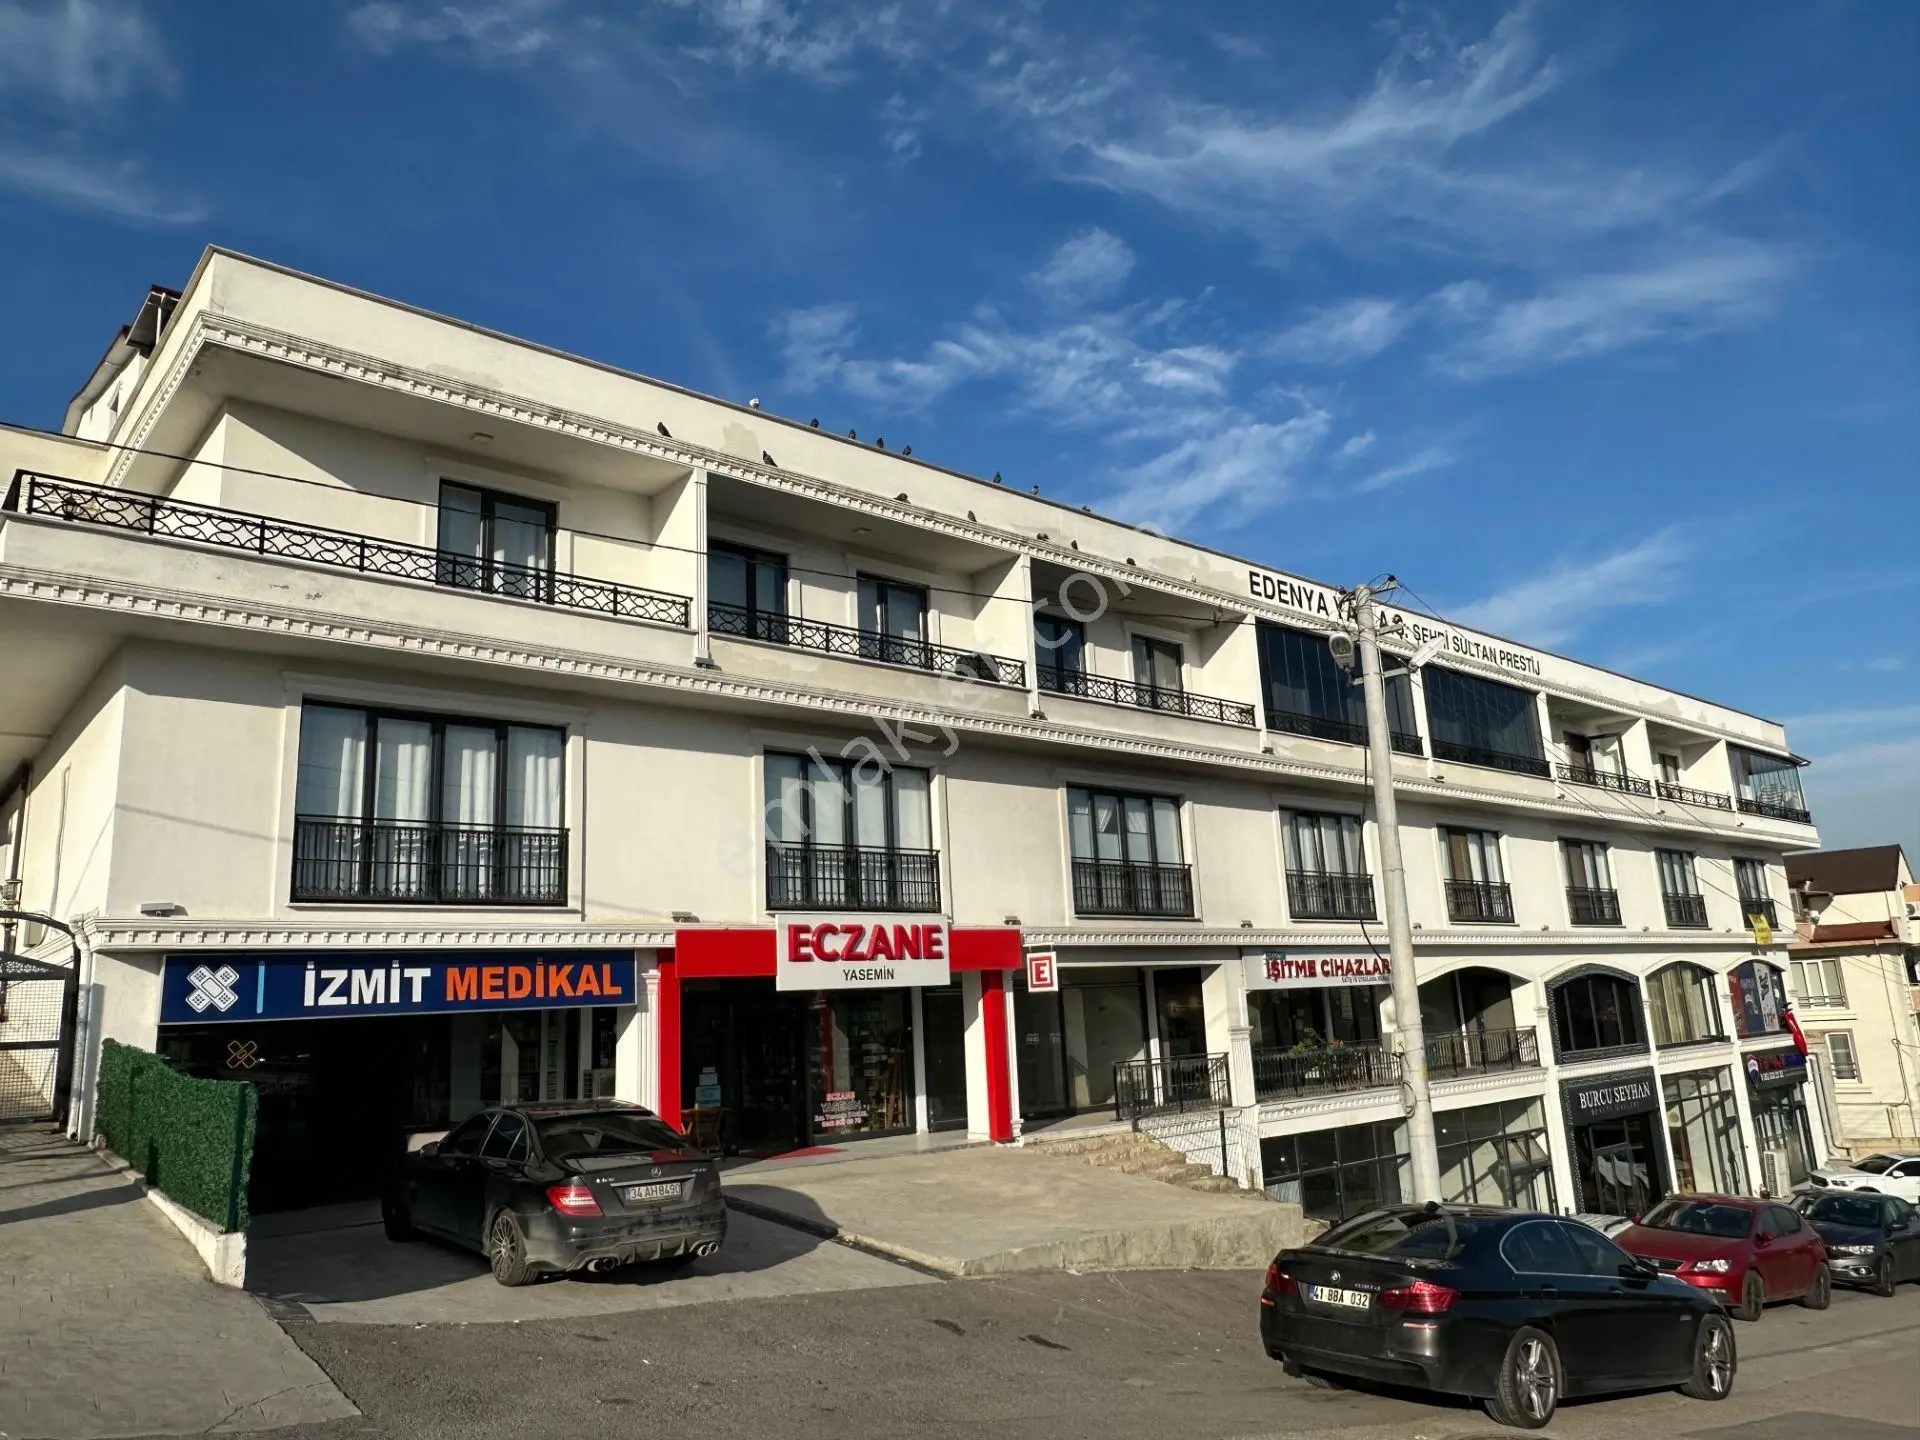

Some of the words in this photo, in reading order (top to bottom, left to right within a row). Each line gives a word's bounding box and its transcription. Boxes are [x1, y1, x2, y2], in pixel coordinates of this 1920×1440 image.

[1249, 570, 1329, 616] EDENYA
[1333, 594, 1375, 630] YA
[1452, 636, 1498, 665] SULTAN
[1500, 650, 1540, 676] PRESTİJ
[788, 922, 945, 963] ECZANE
[843, 965, 894, 981] YASEMİN
[1035, 962, 1048, 982] E
[1320, 957, 1391, 978] CİHAZLAR
[303, 960, 431, 1007] İZMİT
[445, 957, 622, 1001] MEDİKAL
[1579, 1088, 1613, 1109] BURCU
[1613, 1081, 1651, 1103] SEYHAN
[631, 1188, 643, 1199] 34
[1313, 1285, 1324, 1300] 41
[1327, 1287, 1345, 1303] BBA
[1350, 1291, 1368, 1307] 032
